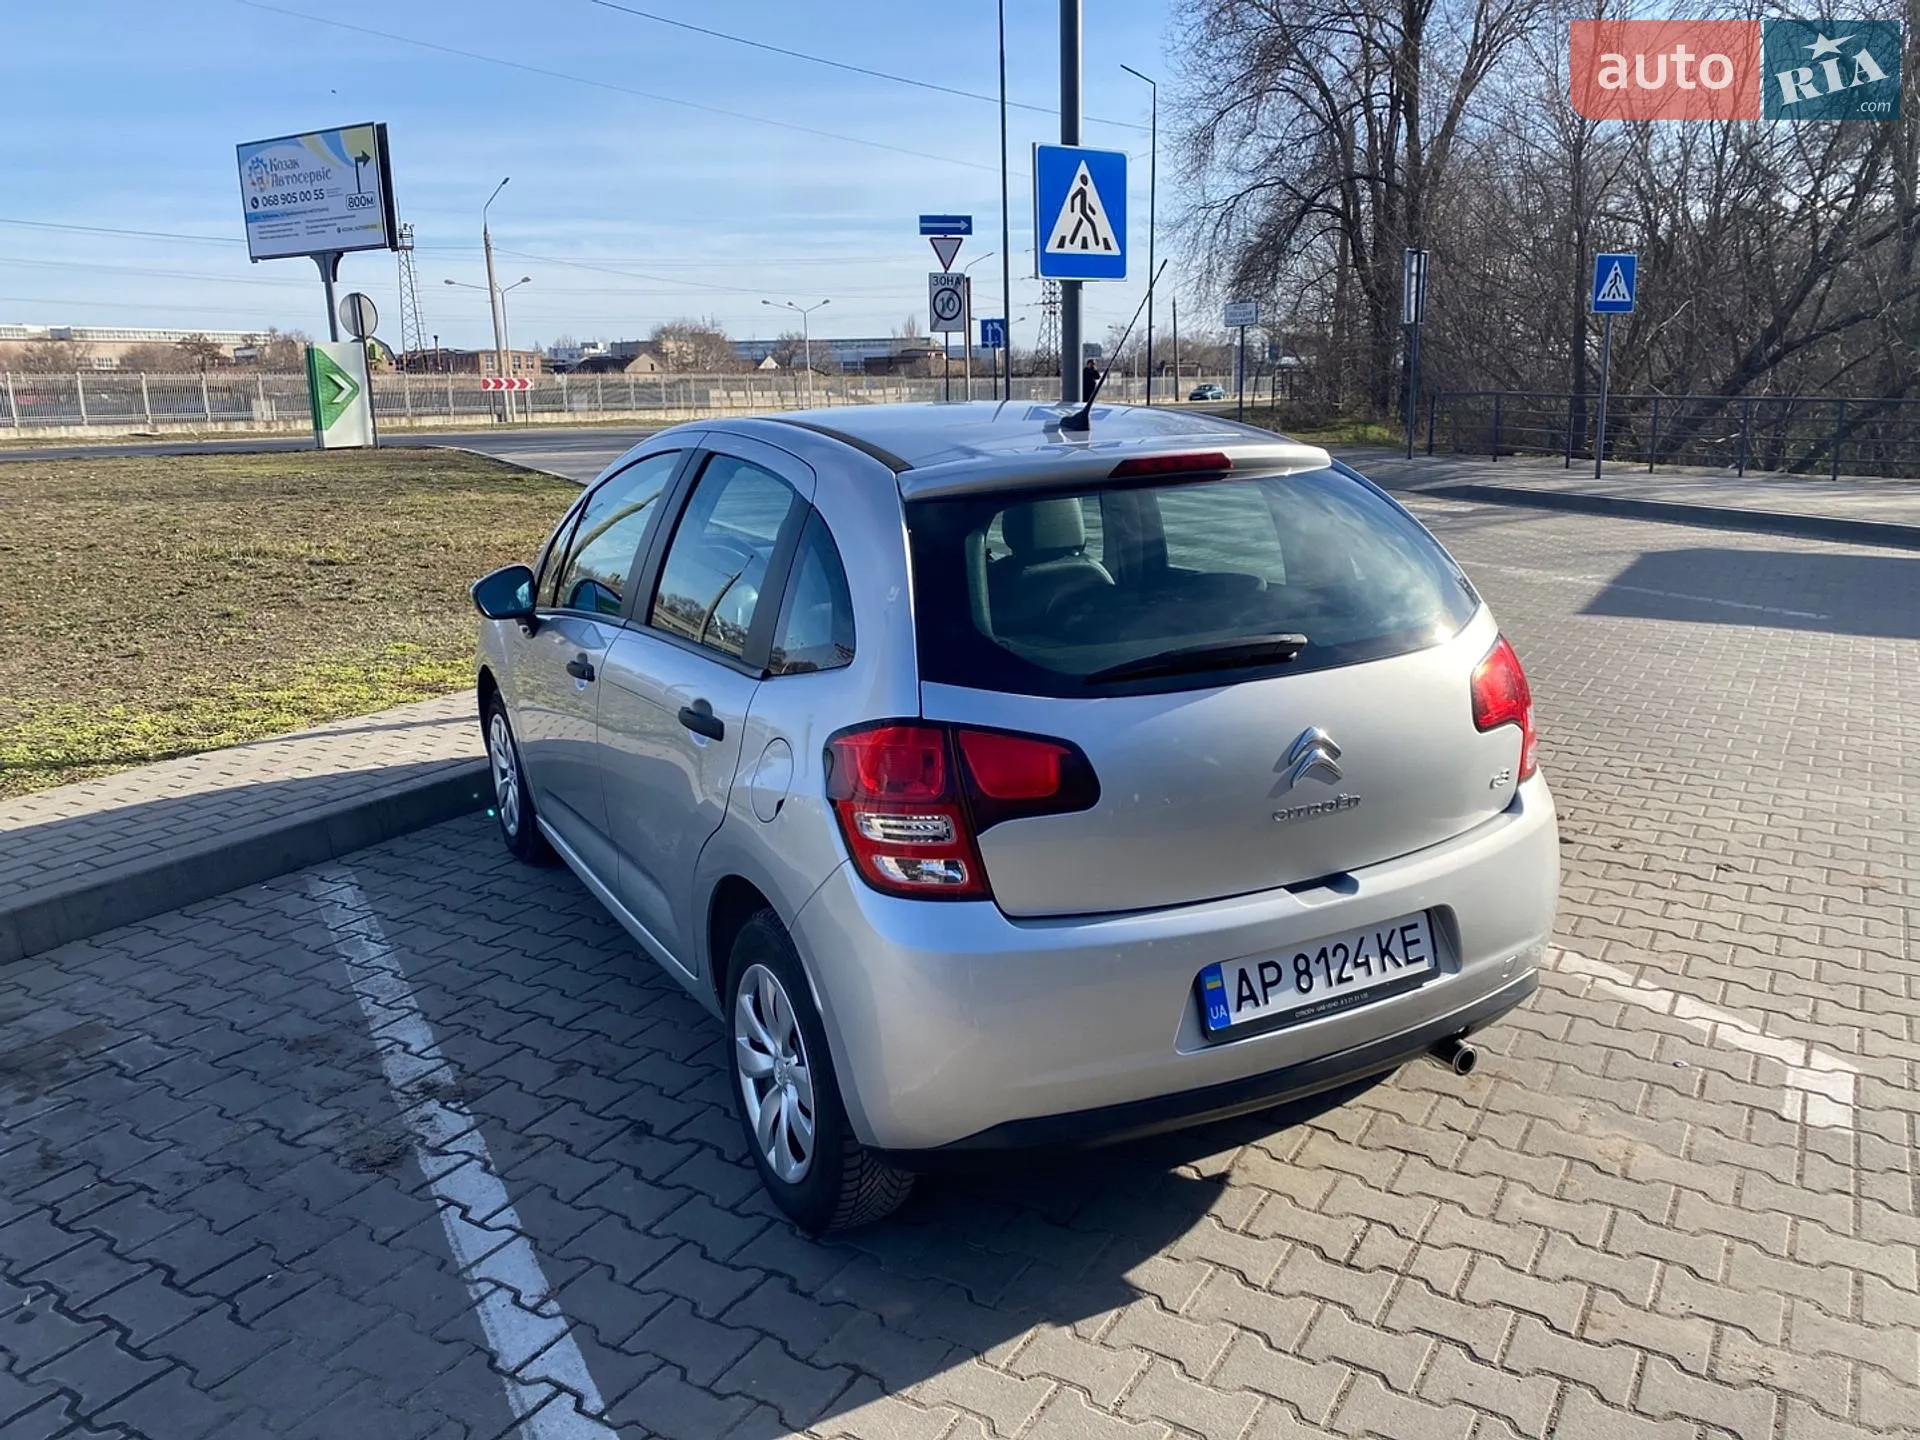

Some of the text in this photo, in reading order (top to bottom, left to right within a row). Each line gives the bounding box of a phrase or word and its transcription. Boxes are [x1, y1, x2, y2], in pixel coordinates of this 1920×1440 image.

[269, 157, 300, 172] Козак
[271, 167, 332, 188] Автосервіс
[262, 195, 279, 207] 068
[281, 192, 298, 205] 905
[299, 190, 312, 203] 00
[313, 188, 325, 201] 55
[932, 276, 962, 286] ЗОНА
[1236, 961, 1283, 1012] AP
[1293, 936, 1373, 994] 8124
[1376, 923, 1425, 972] KE
[1211, 1005, 1228, 1019] UA
